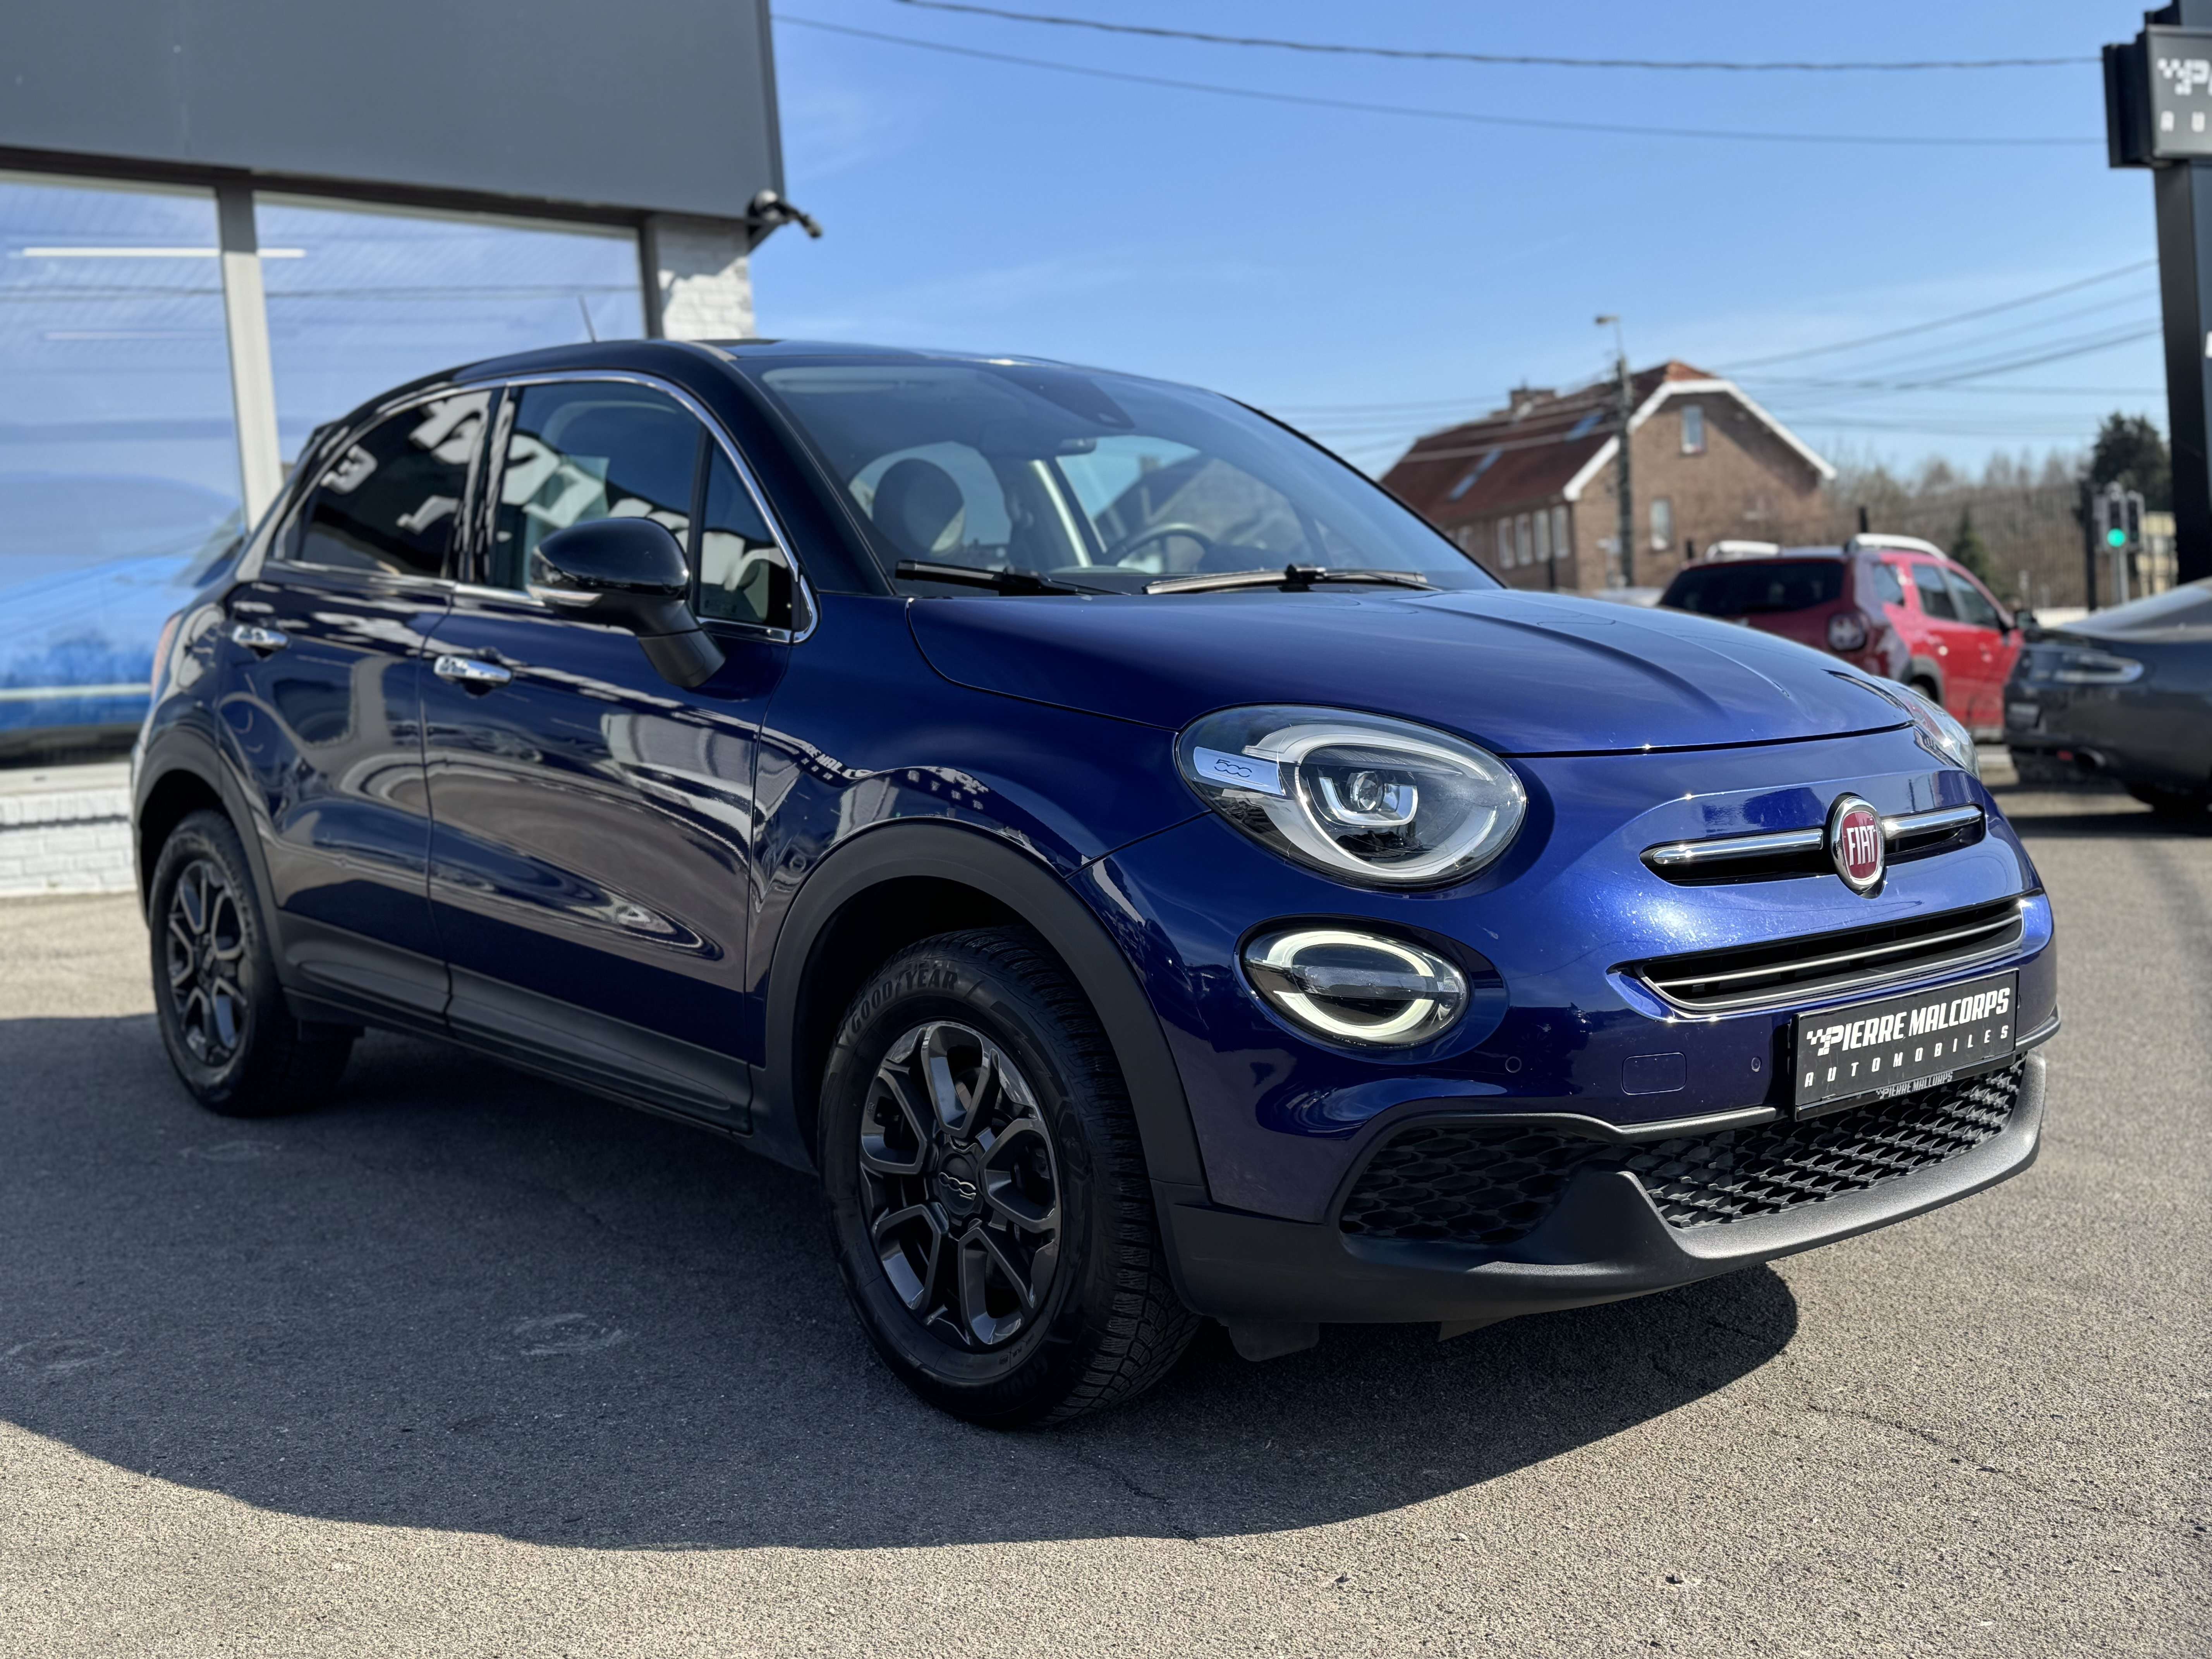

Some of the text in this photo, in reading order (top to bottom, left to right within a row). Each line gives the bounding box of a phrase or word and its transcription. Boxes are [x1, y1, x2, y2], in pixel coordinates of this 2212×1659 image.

[1214, 759, 1252, 778] 500
[1846, 825, 1874, 866] FIAT
[852, 969, 958, 1033] GOODYEAR
[1807, 988, 2010, 1056] PIERRE MALCORPS
[1804, 1025, 2008, 1087] AUTOMOBILES
[1876, 1082, 1911, 1099] PIERRE
